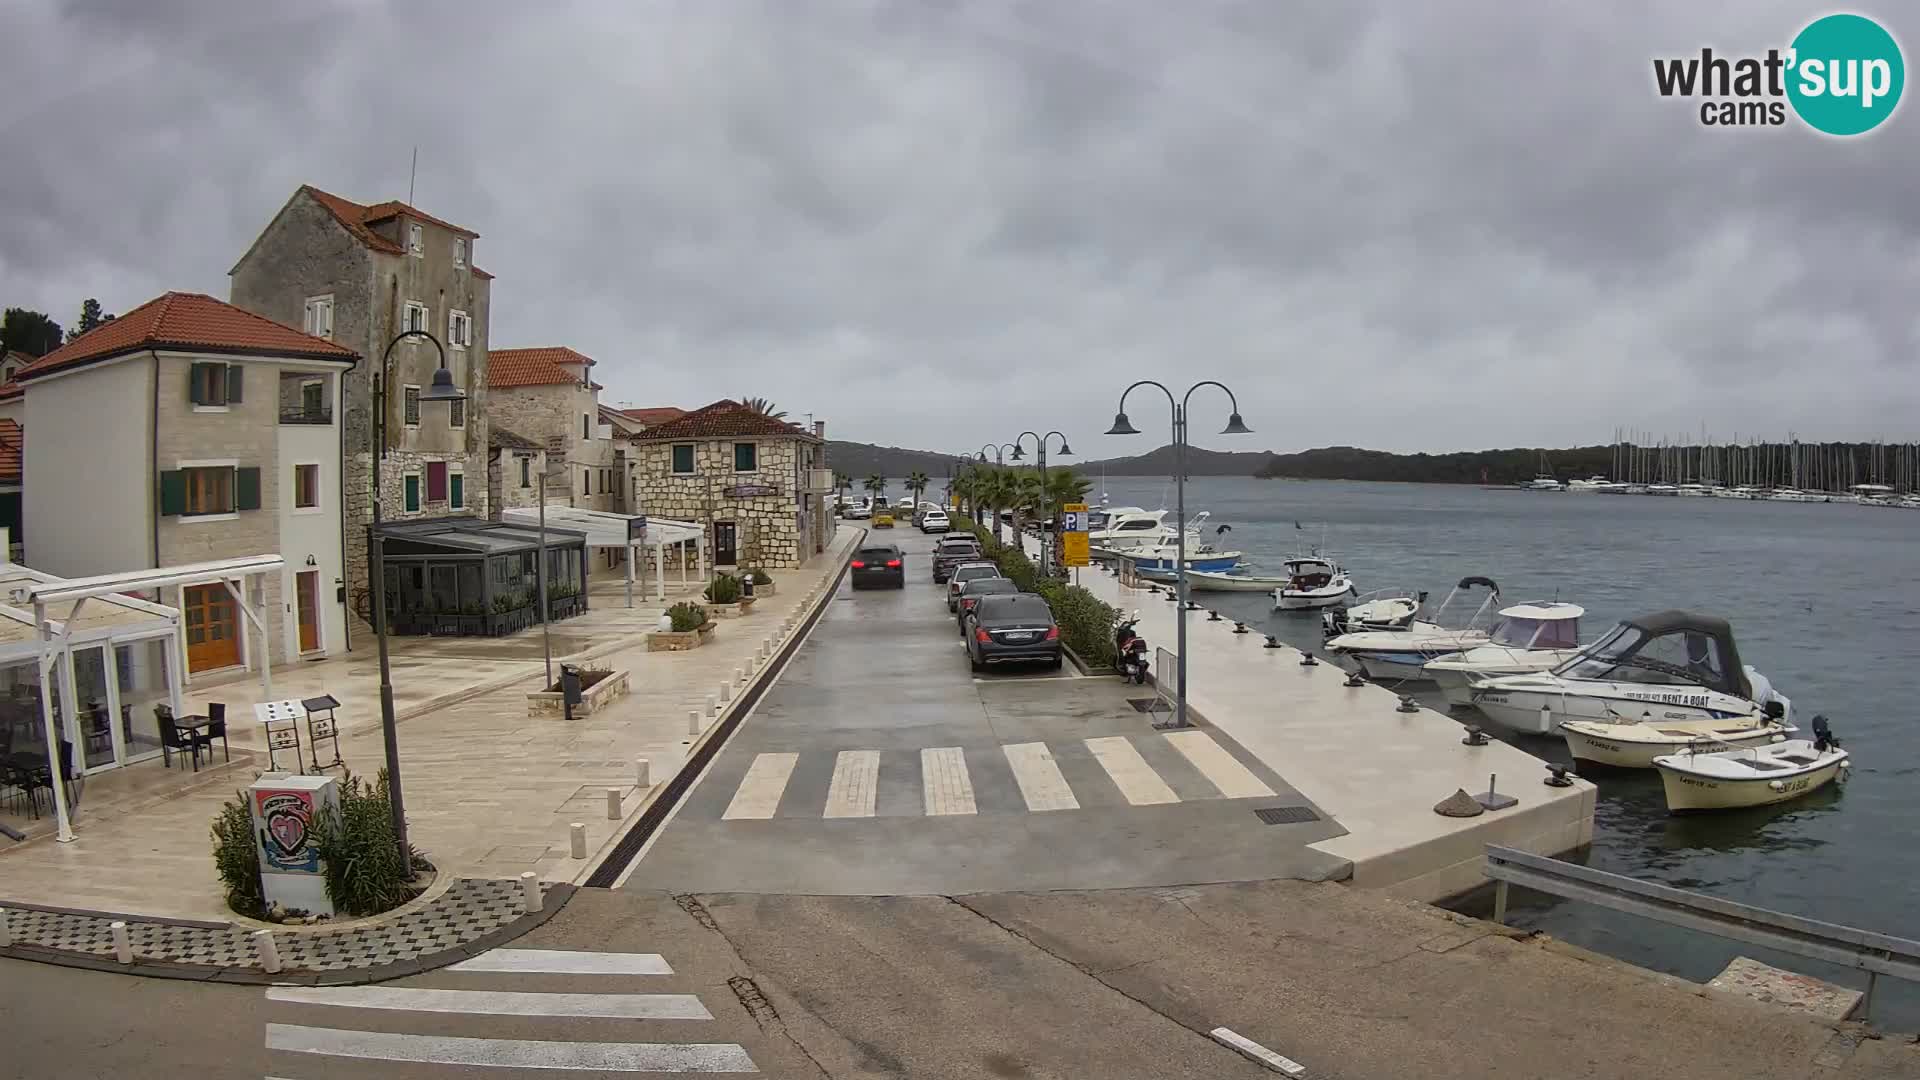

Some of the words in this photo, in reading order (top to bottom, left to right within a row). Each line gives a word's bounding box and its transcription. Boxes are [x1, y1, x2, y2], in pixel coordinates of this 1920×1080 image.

[1066, 513, 1076, 530] P
[1662, 693, 1682, 705] RENT
[1683, 695, 1689, 705] A
[1690, 695, 1710, 708] BOAT
